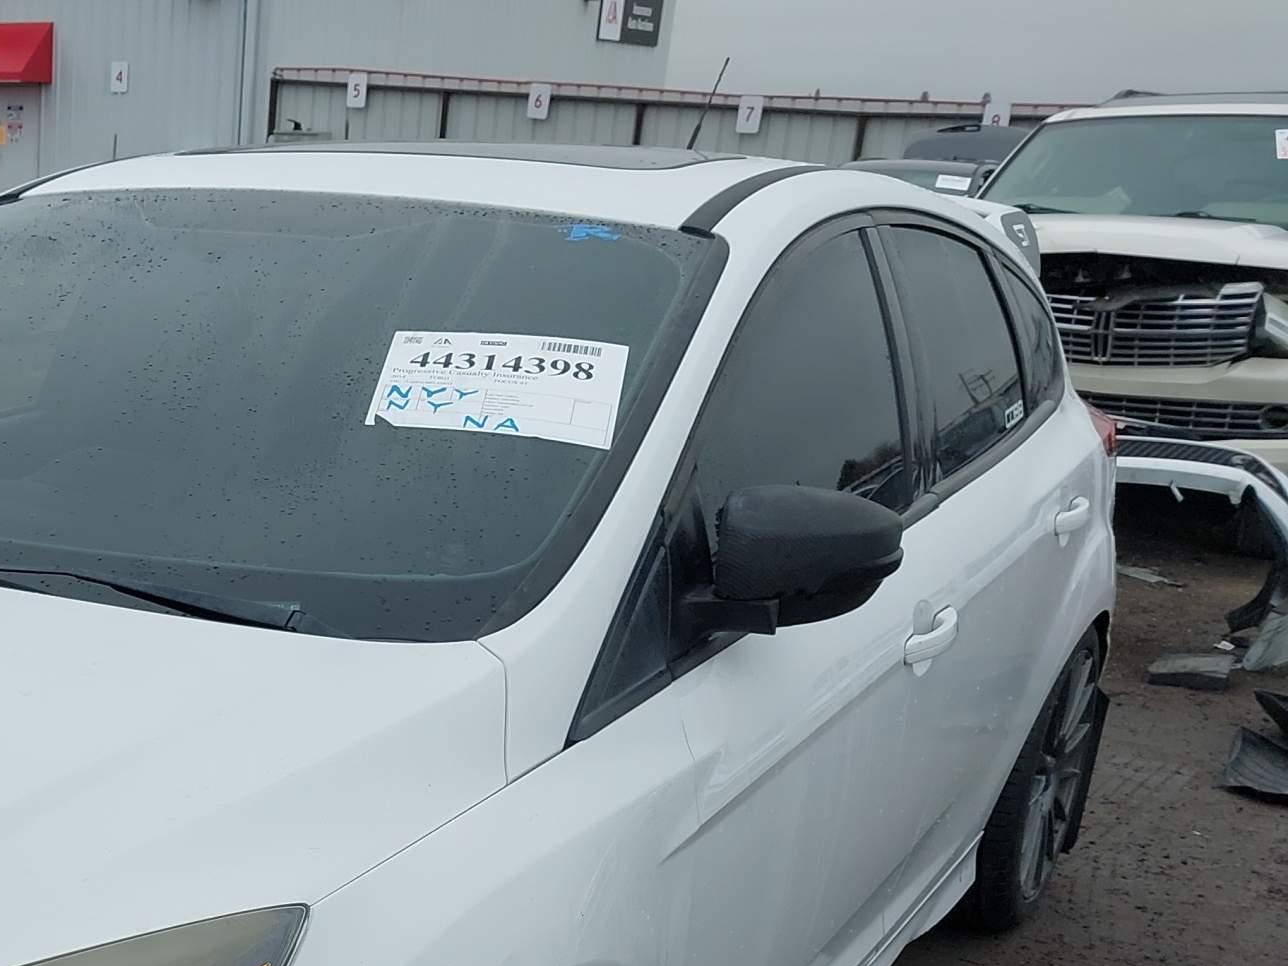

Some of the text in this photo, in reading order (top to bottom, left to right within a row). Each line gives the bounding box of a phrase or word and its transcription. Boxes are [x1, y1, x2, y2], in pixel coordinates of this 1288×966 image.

[115, 70, 123, 84] 4
[352, 83, 361, 99] 5
[534, 94, 543, 109] 6
[745, 106, 755, 123] 7
[392, 367, 447, 375] Progressive
[448, 369, 490, 378] Casualty
[492, 372, 539, 380] Insurance
[409, 351, 595, 381] 44314398
[386, 384, 413, 399] N
[386, 399, 410, 411] N
